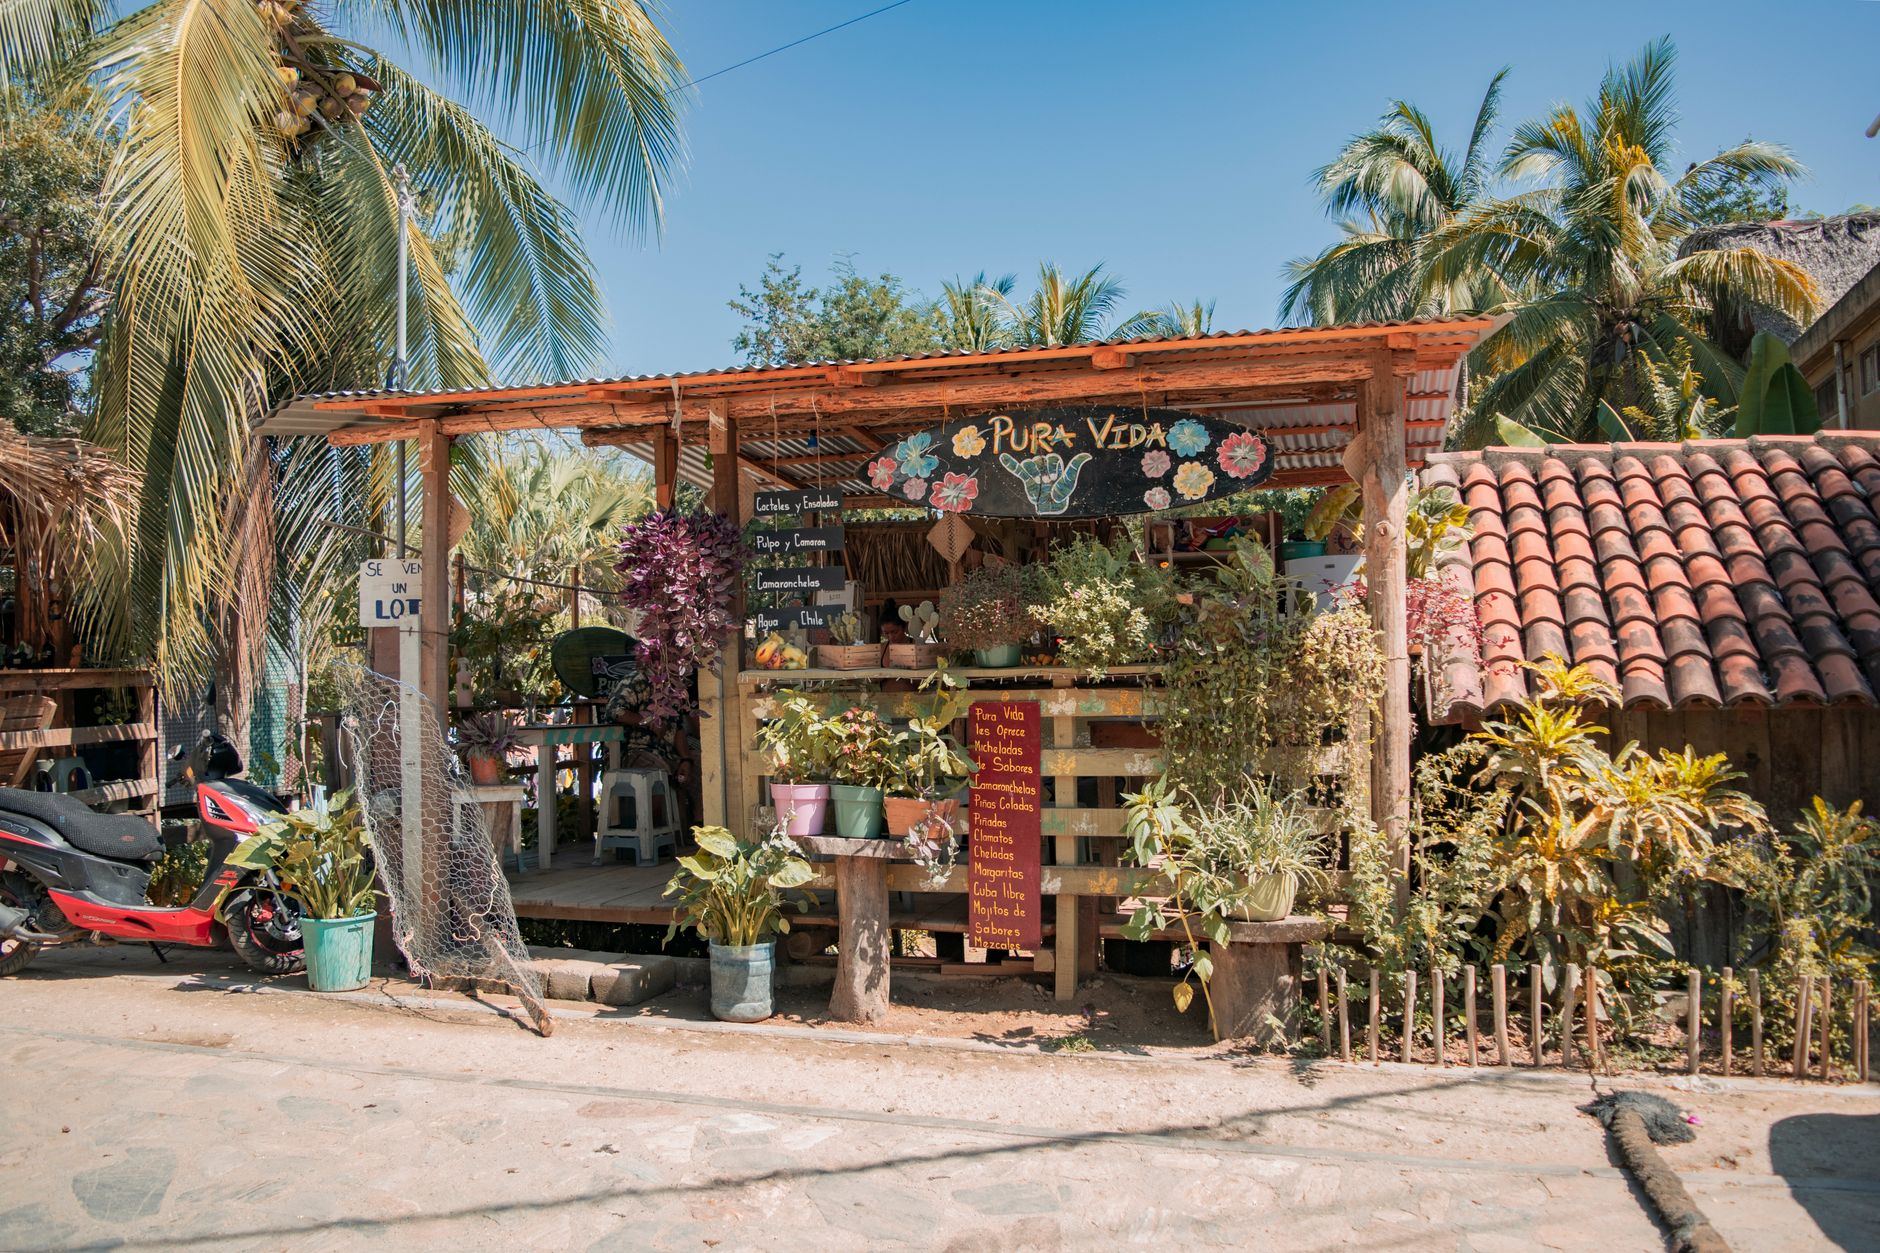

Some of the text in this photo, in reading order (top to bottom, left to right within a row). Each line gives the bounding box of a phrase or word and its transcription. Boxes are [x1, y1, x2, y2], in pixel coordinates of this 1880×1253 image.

[988, 413, 1167, 455] PURA VIDA
[795, 502, 802, 513] y
[803, 494, 839, 509] Ensaladas
[757, 533, 826, 552] Pulpo y Camaron
[365, 561, 422, 577] SE VEN
[392, 582, 407, 594] UN
[757, 571, 820, 590] Camaronchelas
[375, 598, 422, 619] LOT
[757, 610, 824, 631] Agua Chile
[975, 705, 1025, 721] Pura Vida
[975, 723, 1026, 739] les Ofrece
[975, 740, 1023, 755] Micheladas
[993, 756, 1033, 774] Sabores
[999, 797, 1034, 812] Coladas
[974, 829, 1013, 844] Clamatos
[974, 845, 1014, 860] Cheladas
[974, 862, 1024, 883] Margaritas
[973, 881, 1025, 901] Cuba libre
[973, 900, 1026, 921] Mojitos de
[975, 922, 1021, 937] Sabores
[974, 936, 1021, 950] Mezcales
